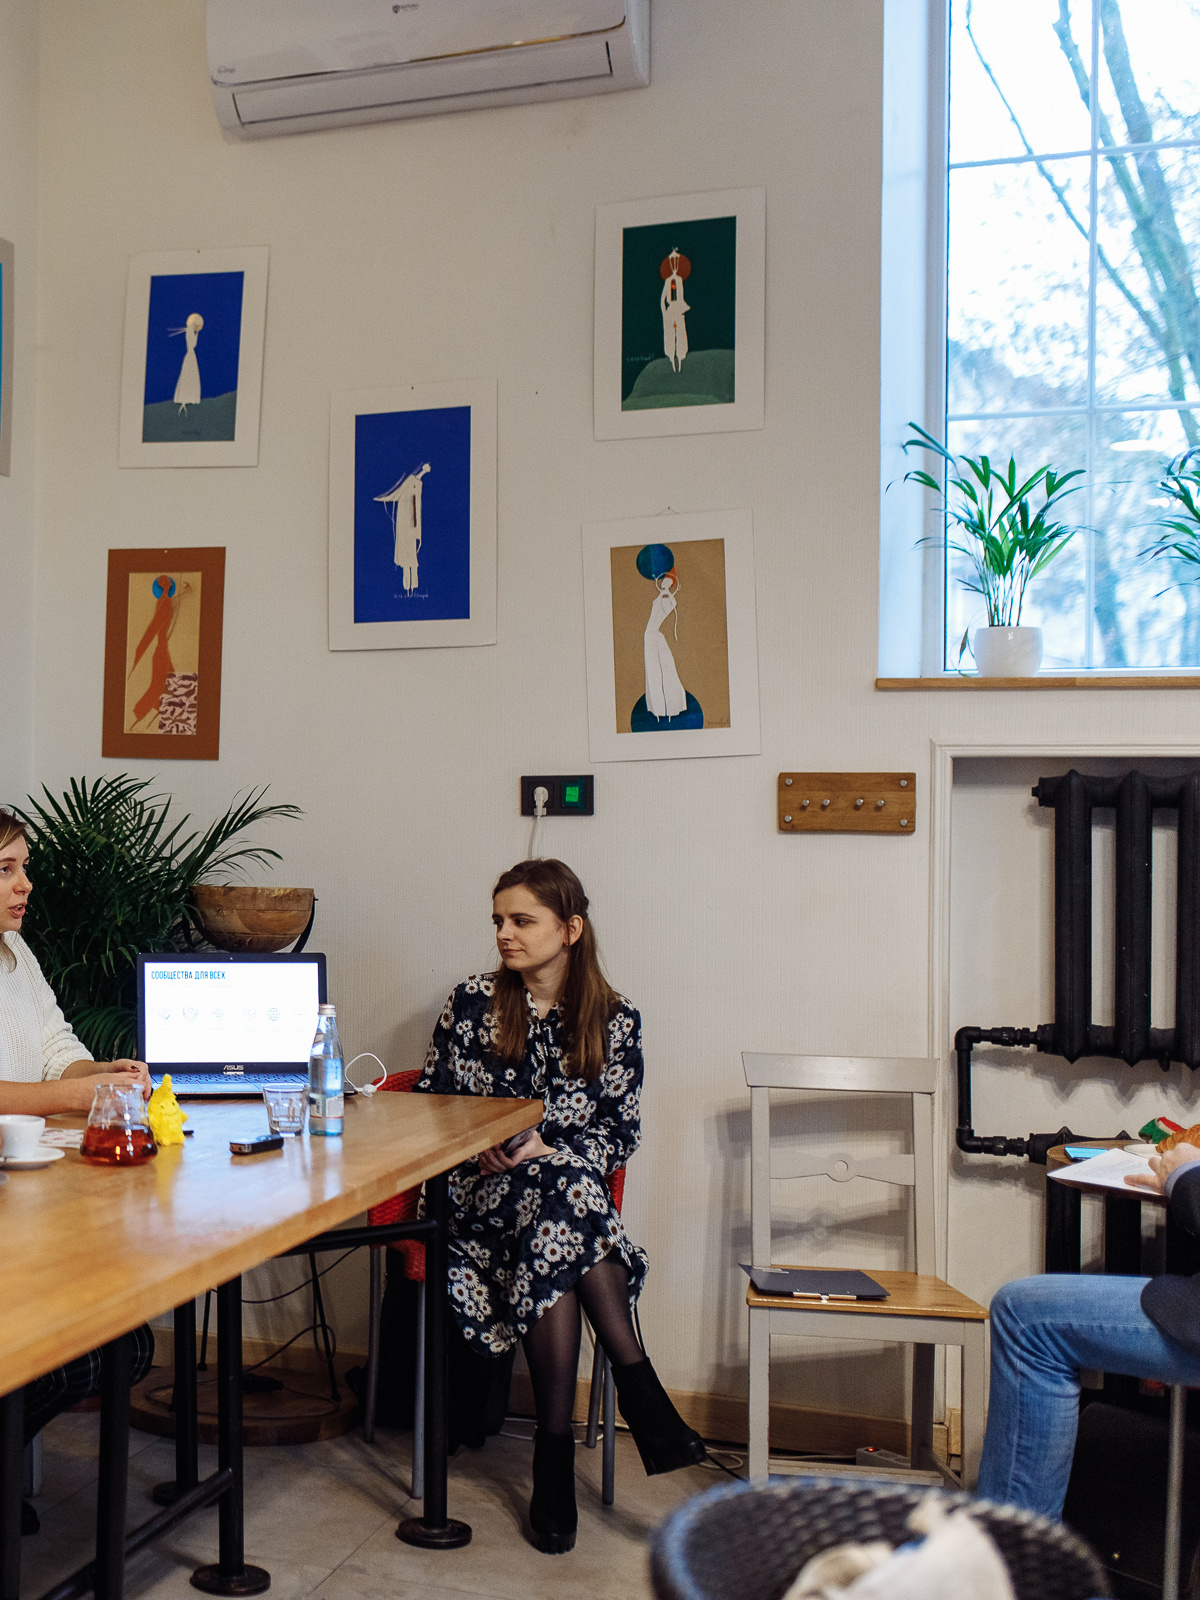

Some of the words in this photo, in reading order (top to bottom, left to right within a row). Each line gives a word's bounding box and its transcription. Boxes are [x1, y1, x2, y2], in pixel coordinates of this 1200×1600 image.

[151, 970, 193, 980] СООБЩЕСТВА
[194, 970, 209, 980] ДЛЯ
[209, 970, 226, 980] ВСЕХ
